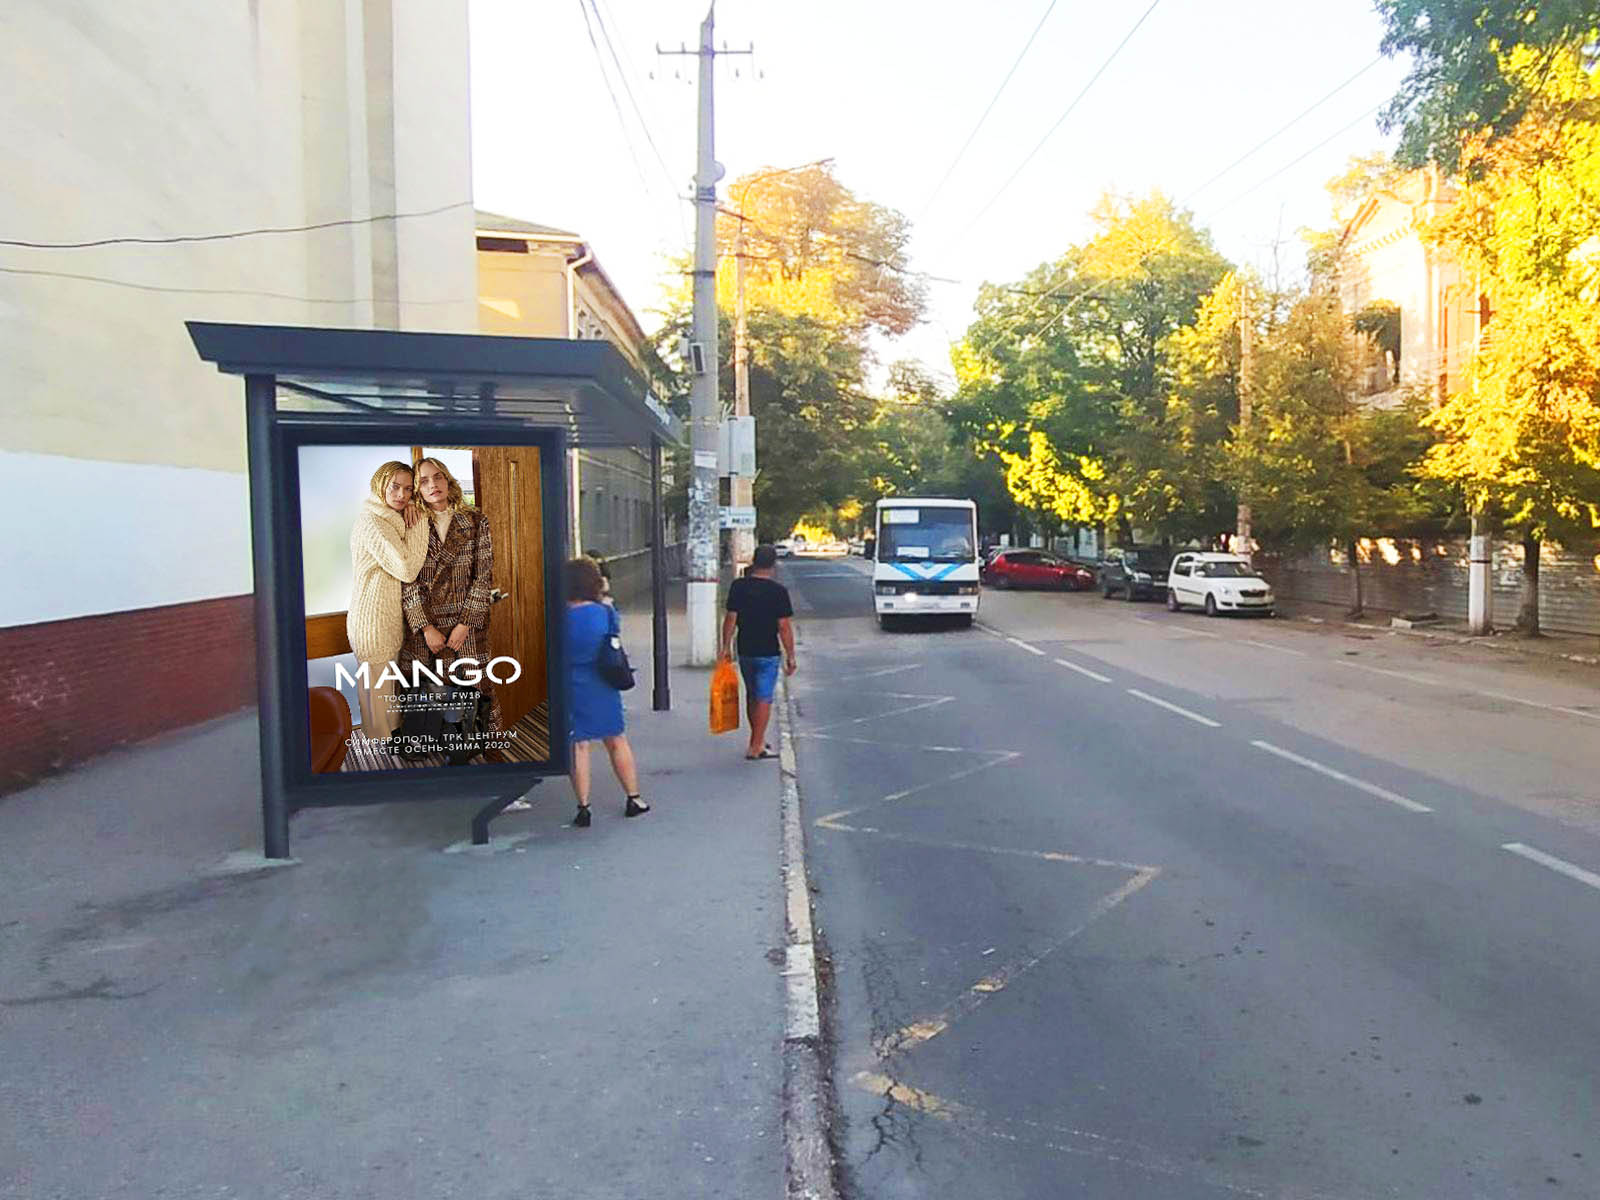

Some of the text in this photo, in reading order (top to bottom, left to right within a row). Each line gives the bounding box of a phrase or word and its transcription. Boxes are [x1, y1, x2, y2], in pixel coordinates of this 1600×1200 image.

[334, 656, 521, 690] MANGO
[452, 691, 481, 700] FW18
[443, 733, 463, 742] ТРК
[467, 731, 518, 741] ЦЕНТРУМ
[354, 741, 510, 756] ВМЕСТЕ ОСЕНЬ-ЗИМА 2020
